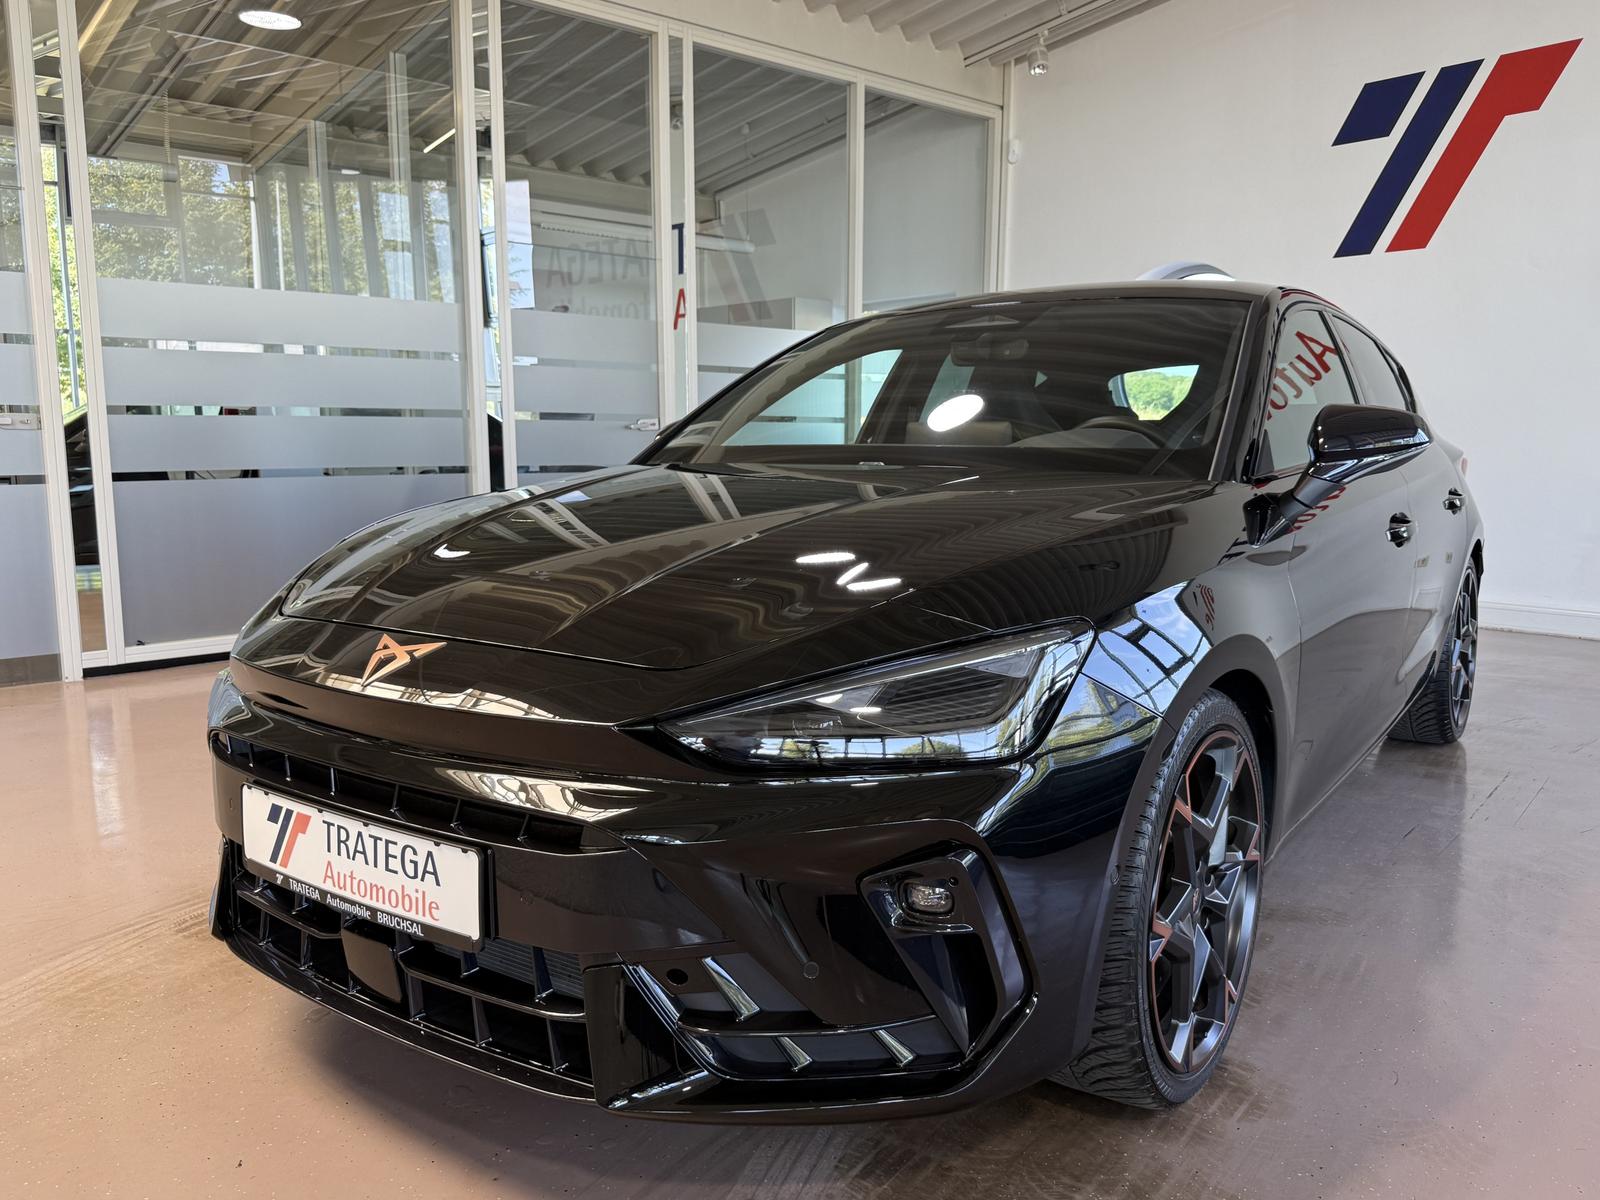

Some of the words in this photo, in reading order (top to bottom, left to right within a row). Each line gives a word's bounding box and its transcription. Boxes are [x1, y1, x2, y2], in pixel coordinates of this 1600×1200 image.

[322, 819, 442, 887] TRATEGA
[289, 878, 321, 901] TRATEGA
[326, 896, 371, 920] Automobile
[377, 911, 425, 937] BRUCHSAL
[323, 860, 440, 922] Automobile
